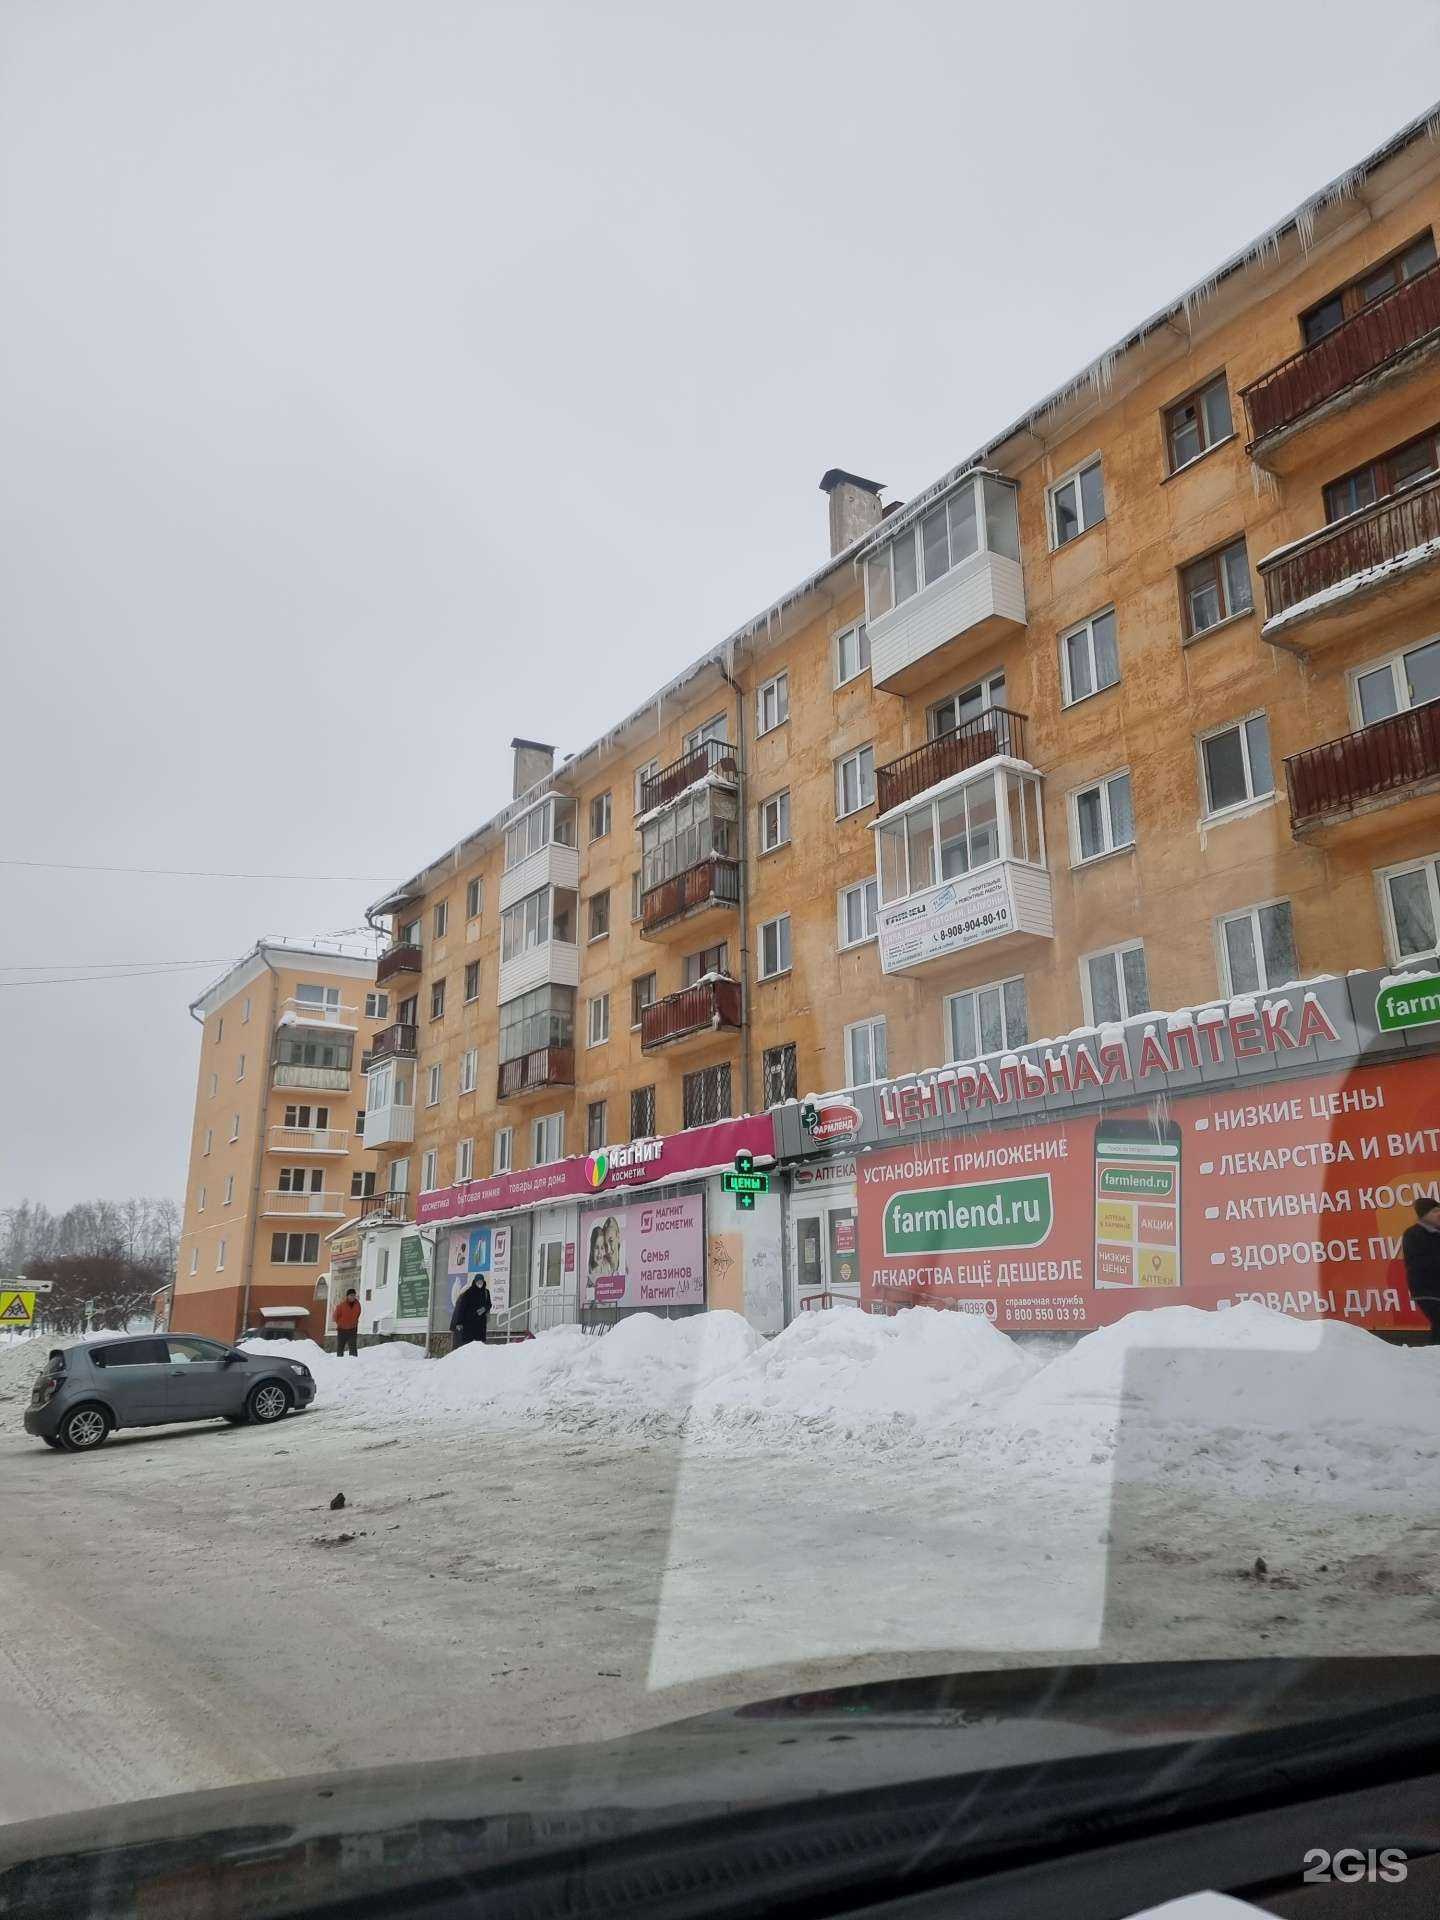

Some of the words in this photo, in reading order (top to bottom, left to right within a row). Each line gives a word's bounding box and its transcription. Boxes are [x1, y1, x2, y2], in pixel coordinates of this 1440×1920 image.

[940, 908, 1006, 940] 8-908-904-80-10
[880, 1041, 1131, 1128] ЦЕНТРАЛЬНАЯ
[1139, 1000, 1341, 1078] АПТЕКА
[1214, 1099, 1304, 1131] НИЗКИЕ
[1309, 1086, 1385, 1120] ЦЕНЫ
[813, 1119, 853, 1135] ФАРМЛЕНД
[864, 1157, 950, 1184] УСТАНОВИТЕ
[953, 1139, 1068, 1171] ПРИЛОЖЕНИЕ
[1219, 1140, 1354, 1175] ЛЕКАРСТВА
[1360, 1136, 1379, 1159] И
[815, 1163, 856, 1181] АПТЕКА
[1104, 1172, 1168, 1188] farmlend.ru
[509, 1180, 533, 1194] товары
[533, 1177, 547, 1190] для
[547, 1173, 566, 1188] дома
[730, 1176, 760, 1190] ЦЕНЫ
[655, 1205, 684, 1218] МАГНИТ
[1225, 1189, 1351, 1220] АКТИВНАЯ
[892, 1195, 1041, 1234] farmlend.ru
[655, 1218, 693, 1232] КОСМЕТИК
[1141, 1218, 1173, 1231] АКЦИИ
[641, 1249, 669, 1263] Семья
[1099, 1251, 1131, 1264] НИЗКИЕ
[1230, 1238, 1361, 1271] ЗДОРОВОЕ
[641, 1267, 692, 1281] магазинов
[872, 1265, 953, 1287] ЛЕКАРСТВА
[957, 1259, 992, 1287] ЕЩЁ
[997, 1259, 1083, 1287] ДЕШЕВЛЕ
[1102, 1263, 1127, 1274] ЦЕНЫ
[641, 1285, 675, 1300] Магнит
[1005, 1297, 1050, 1307] справочная
[1052, 1294, 1083, 1307] служба
[1343, 1289, 1400, 1317] ДЛЯ
[1005, 1309, 1011, 1320] 8
[1014, 1308, 1032, 1320] 800
[1035, 1308, 1053, 1320] 550
[1056, 1308, 1069, 1320] 03
[1073, 1308, 1086, 1320] 93
